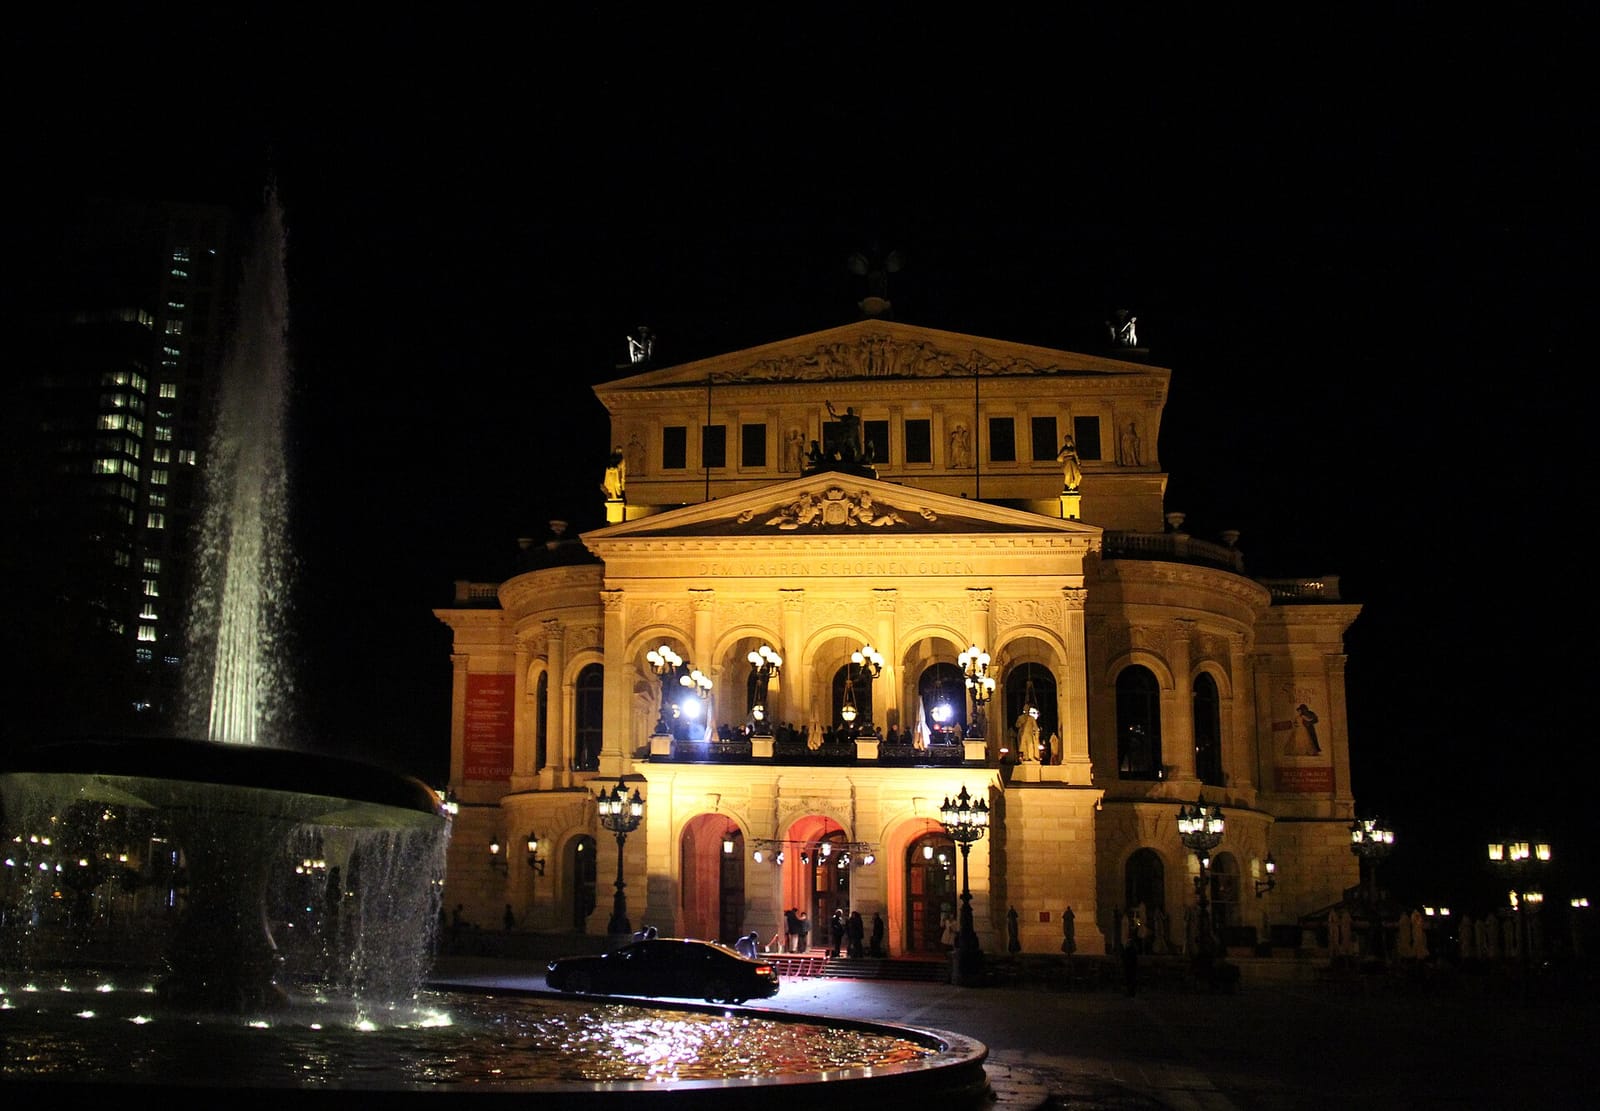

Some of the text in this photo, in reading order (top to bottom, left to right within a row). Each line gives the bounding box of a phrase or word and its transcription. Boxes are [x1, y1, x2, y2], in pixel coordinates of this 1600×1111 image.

[699, 560, 975, 576] DEM WAHREN SCHOENEN GUTEN
